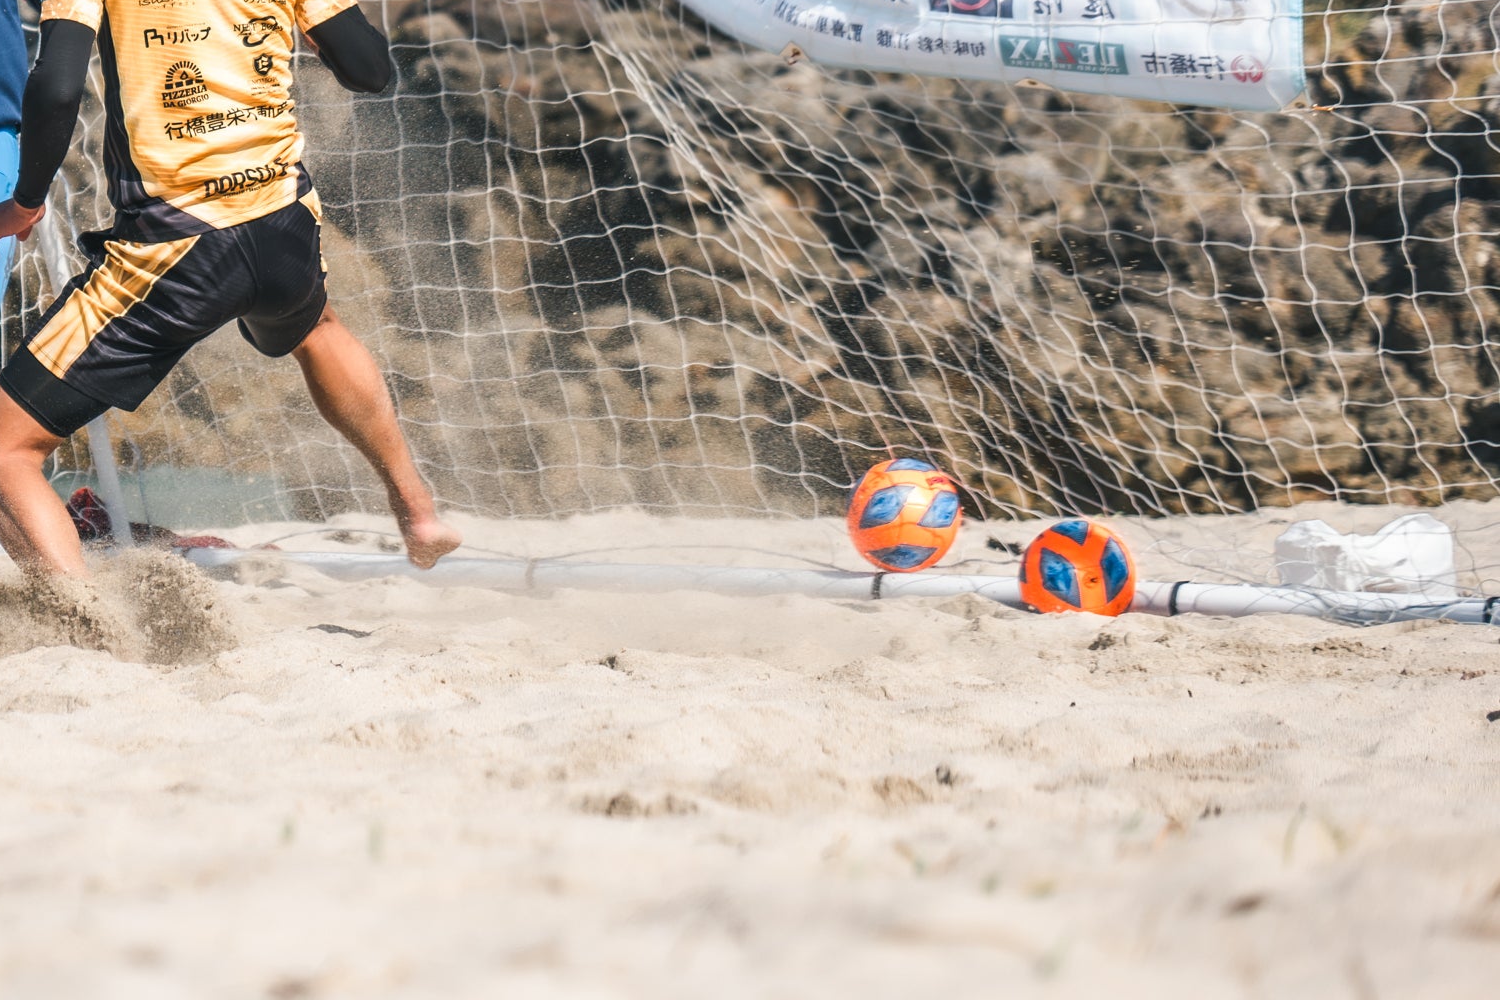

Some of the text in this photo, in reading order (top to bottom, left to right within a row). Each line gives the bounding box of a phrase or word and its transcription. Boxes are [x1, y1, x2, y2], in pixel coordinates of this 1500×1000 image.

[167, 27, 211, 45] リバップ
[162, 84, 208, 101] PIZZERIA
[163, 94, 210, 109] DA GIORGIO
